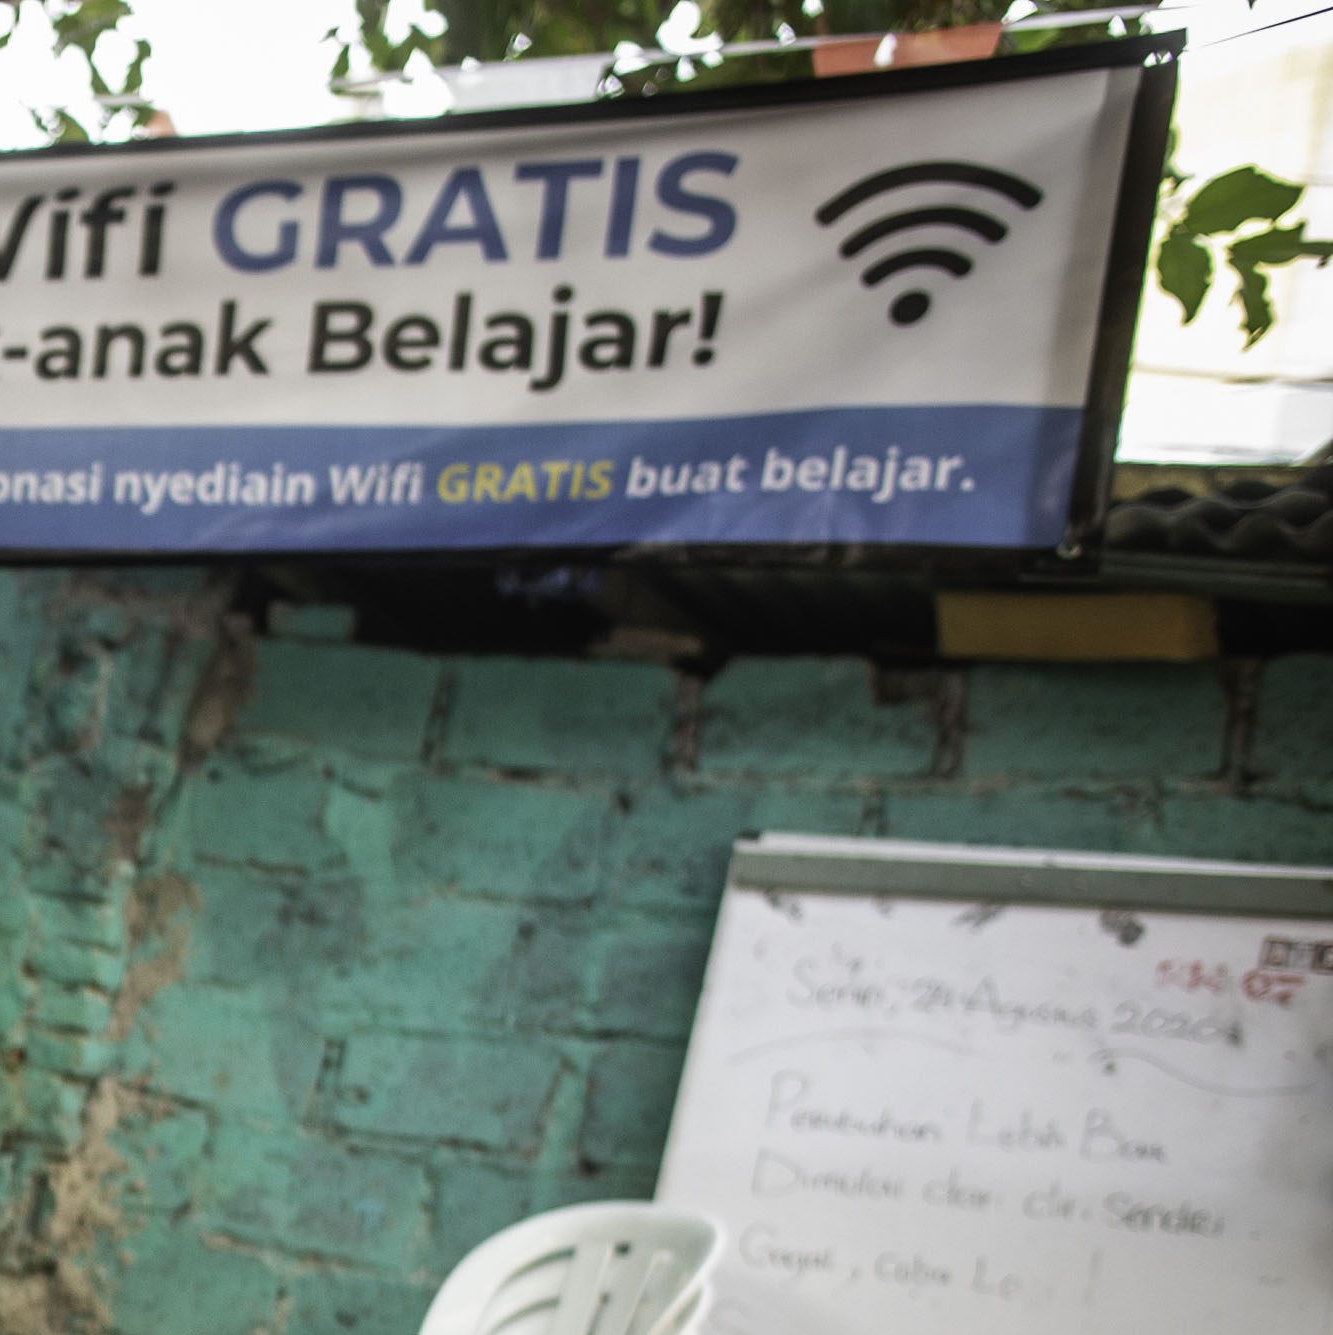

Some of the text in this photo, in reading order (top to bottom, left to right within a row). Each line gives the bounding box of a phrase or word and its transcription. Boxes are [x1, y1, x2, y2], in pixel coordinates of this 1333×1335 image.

[212, 151, 741, 274] GRATIS
[305, 286, 726, 391] Belajar!
[113, 459, 315, 515] nyediain
[330, 462, 423, 506] Wifi
[437, 461, 615, 503] GRATIS
[625, 456, 746, 499] buat
[759, 446, 976, 503] belajar.
